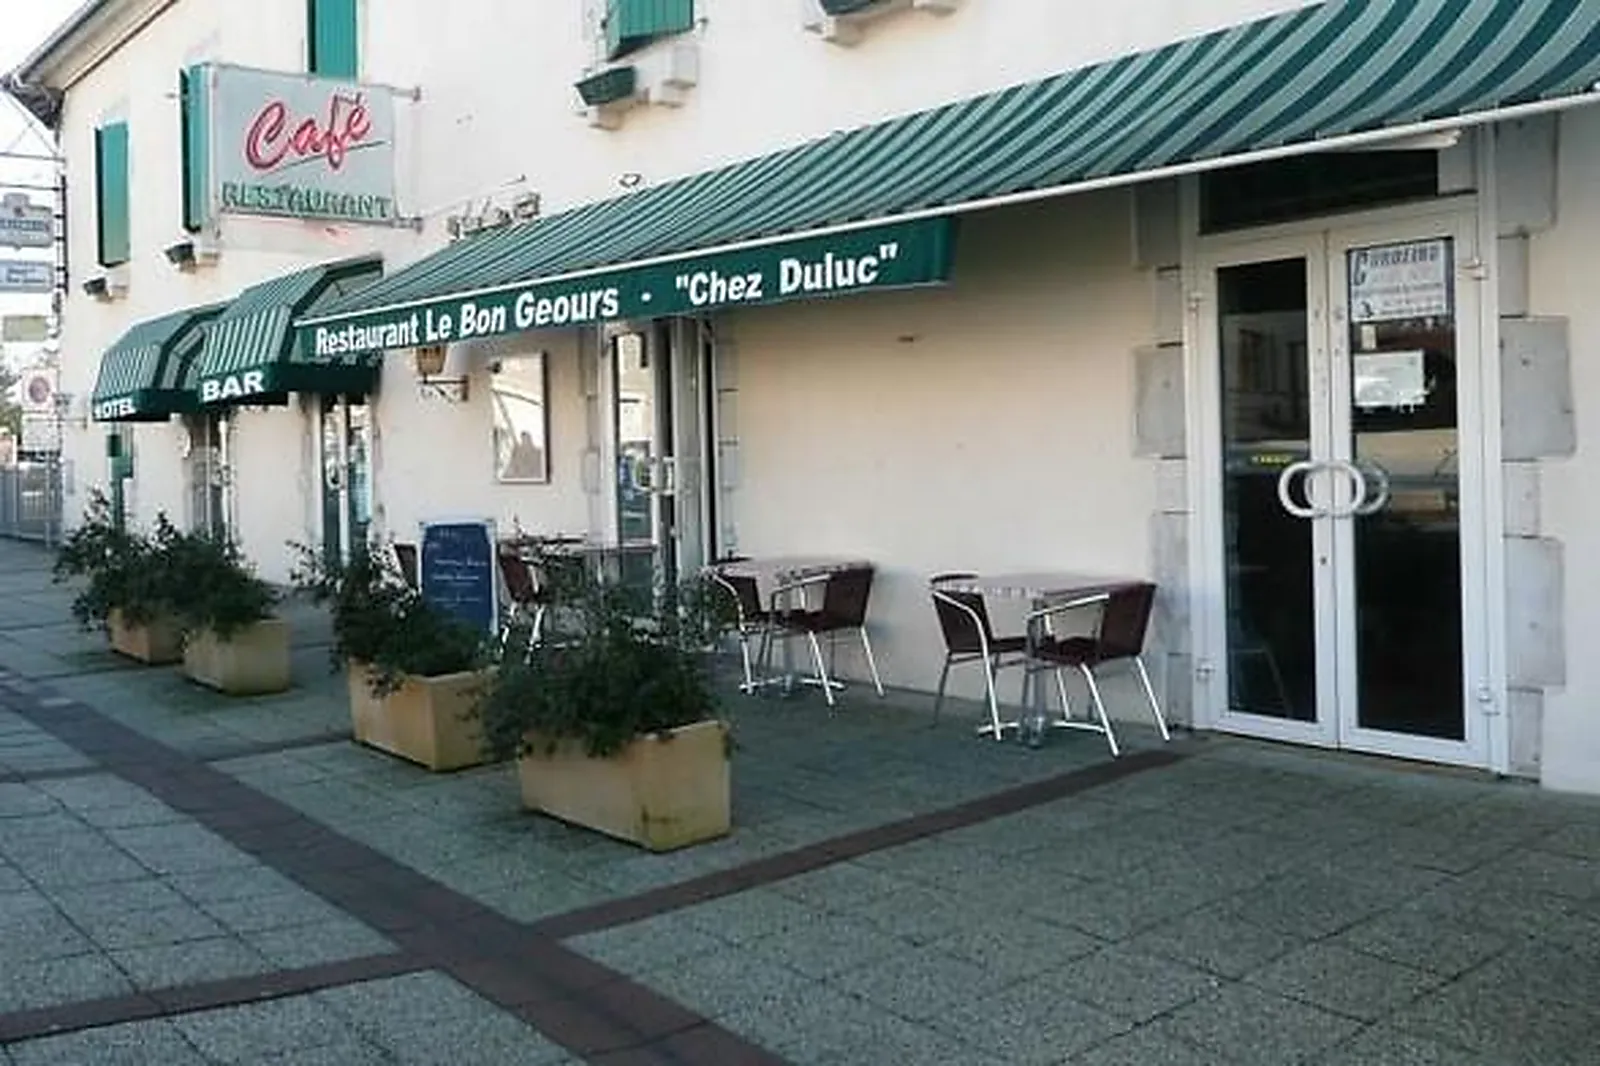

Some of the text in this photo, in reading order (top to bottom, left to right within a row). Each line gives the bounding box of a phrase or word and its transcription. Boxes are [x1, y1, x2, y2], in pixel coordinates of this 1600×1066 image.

[245, 91, 371, 170] Café
[221, 180, 392, 218] RESTAURANT
[315, 242, 899, 356] Restaurant Le Bon Geours "Chez Duluc"
[202, 371, 266, 403] BAR
